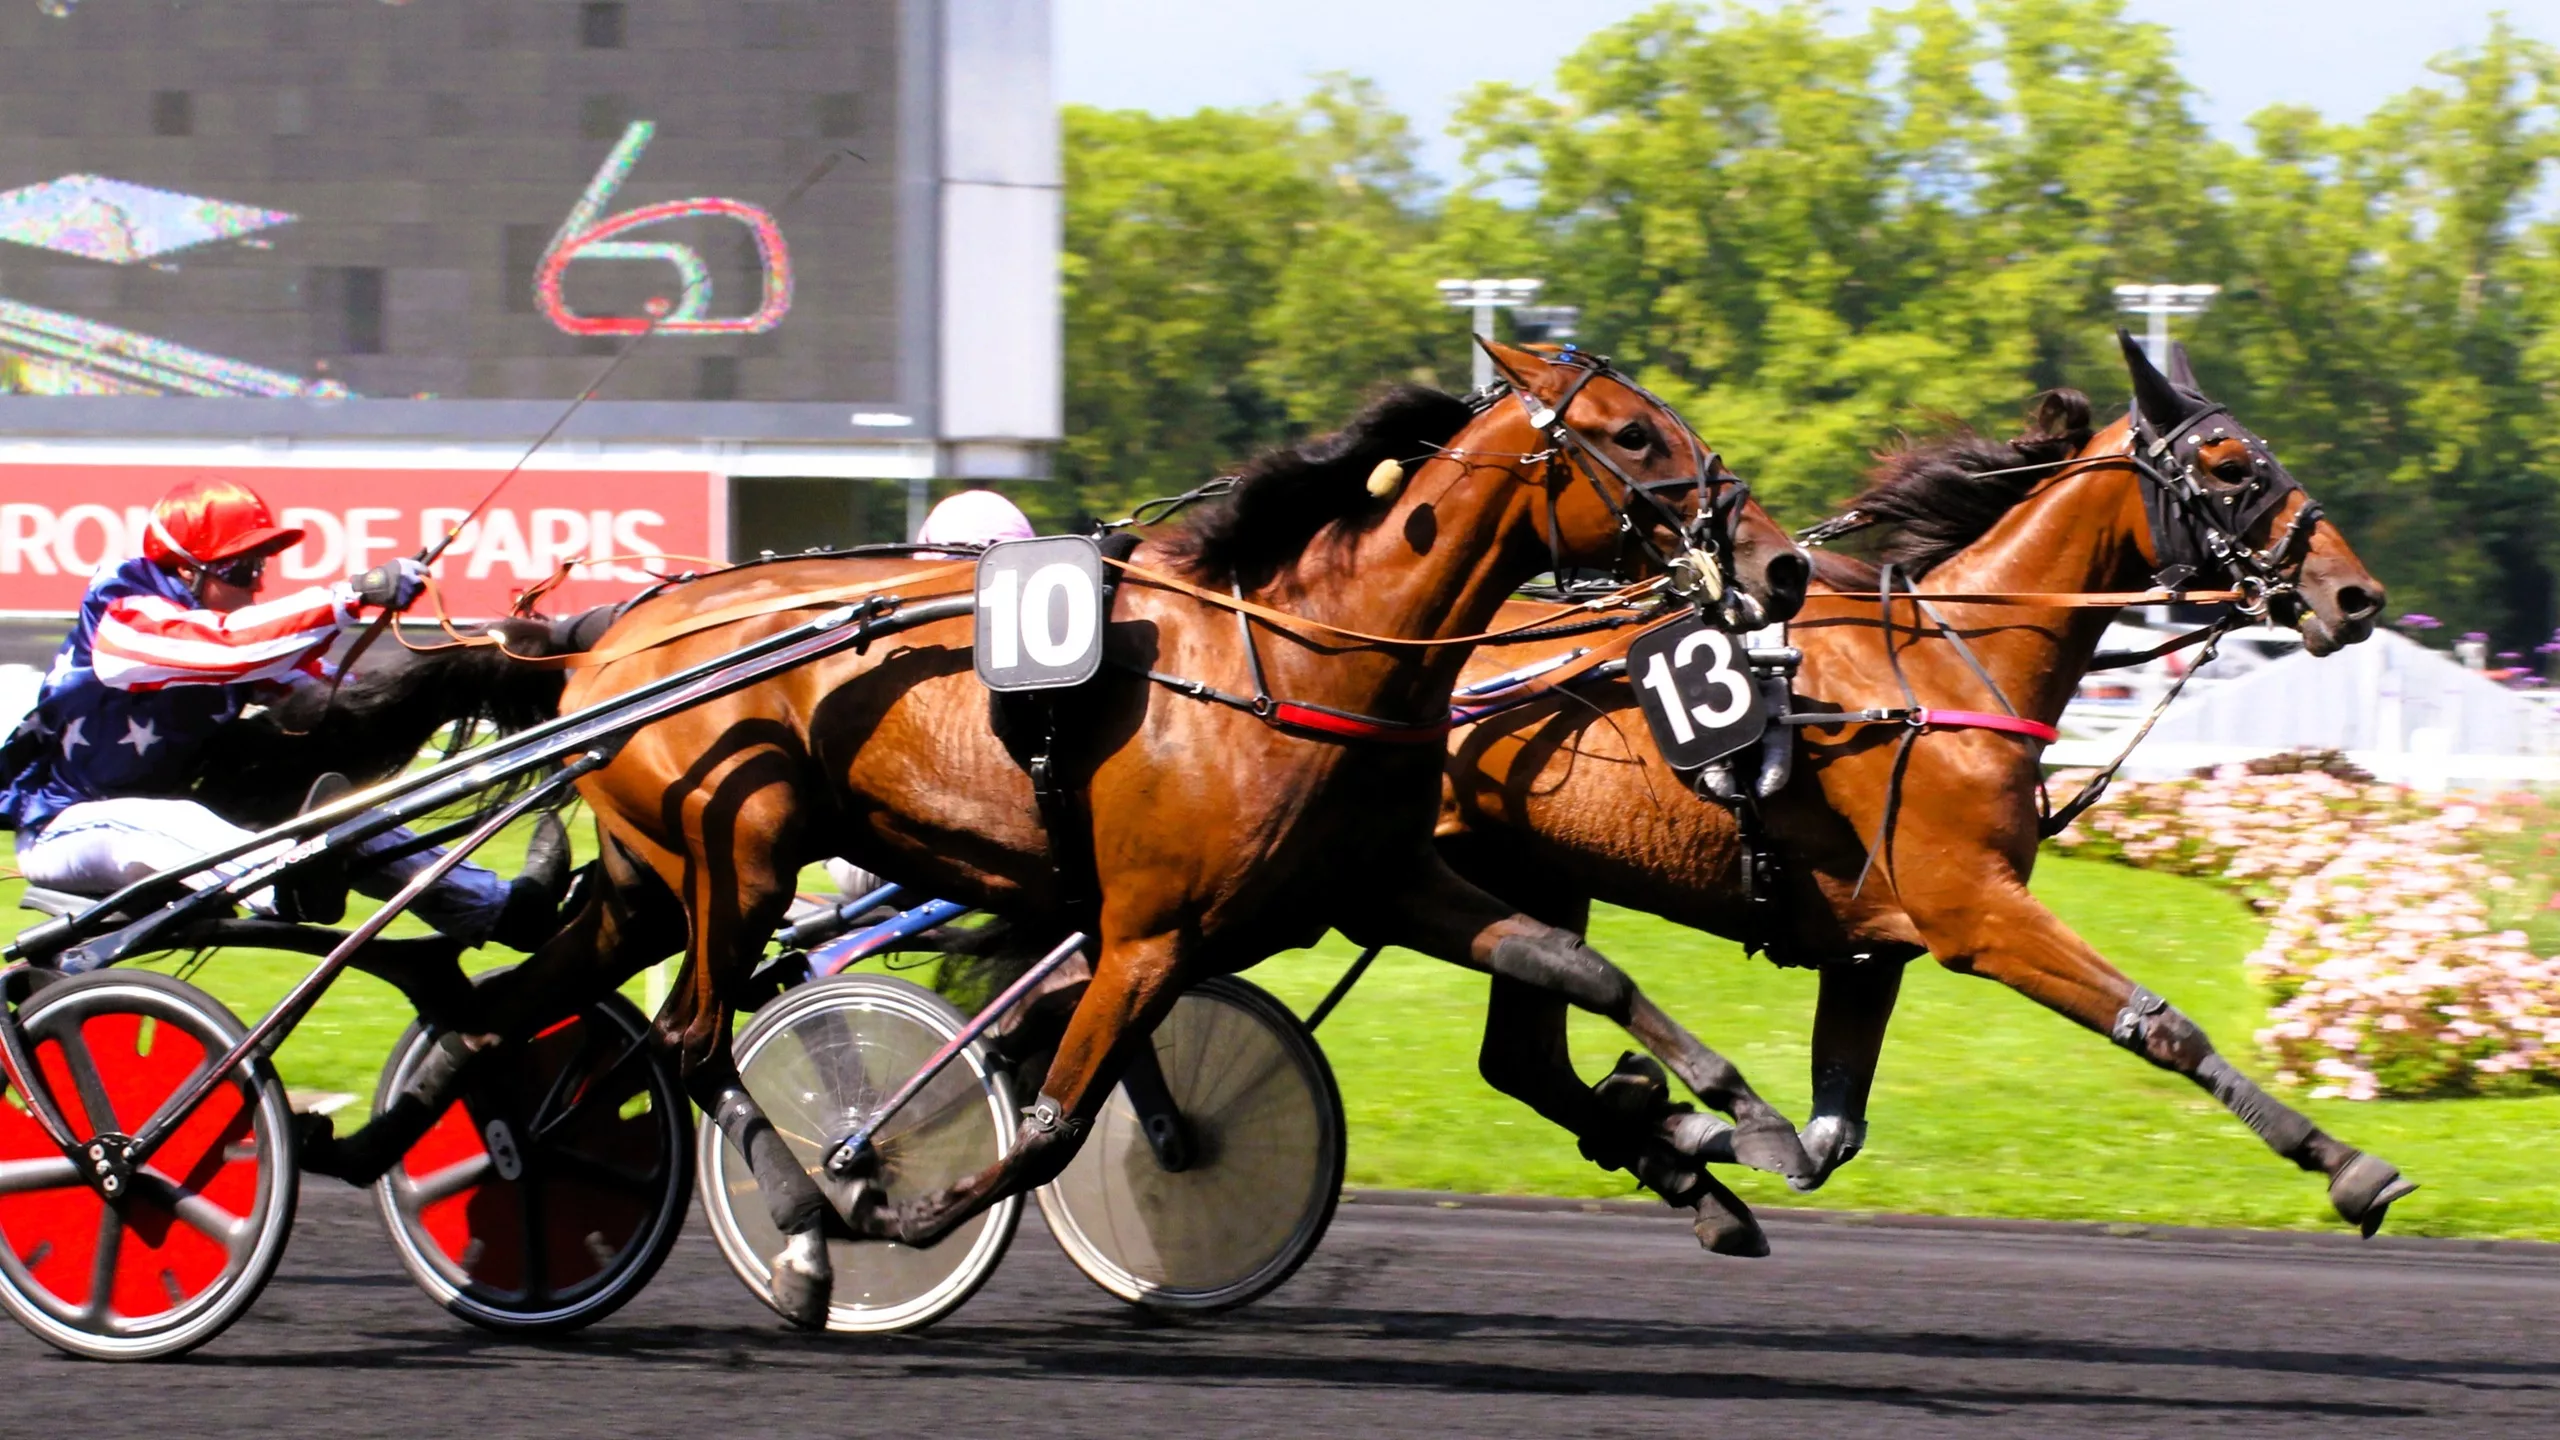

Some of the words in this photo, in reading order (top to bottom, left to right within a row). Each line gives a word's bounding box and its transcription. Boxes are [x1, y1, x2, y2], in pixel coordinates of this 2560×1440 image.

[420, 507, 667, 584] PARIS
[978, 562, 1097, 669] 10
[1641, 629, 1752, 745] 13
